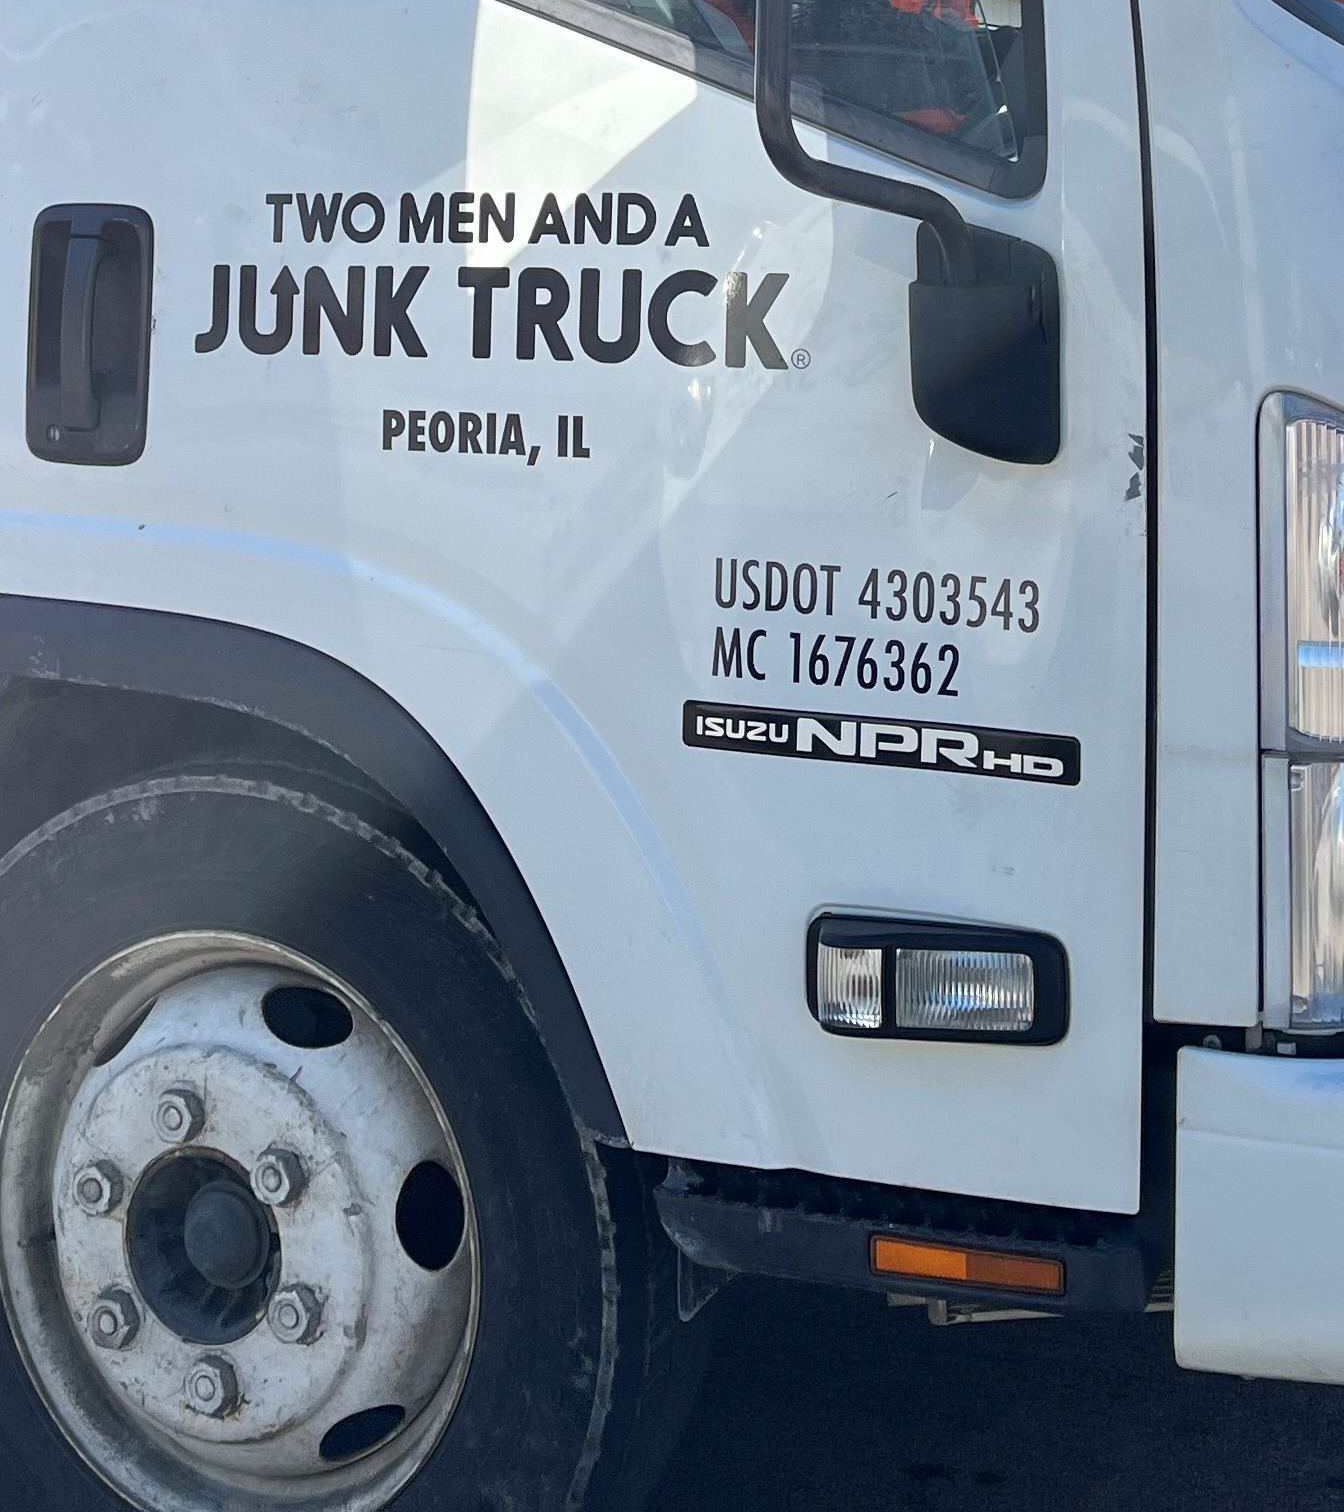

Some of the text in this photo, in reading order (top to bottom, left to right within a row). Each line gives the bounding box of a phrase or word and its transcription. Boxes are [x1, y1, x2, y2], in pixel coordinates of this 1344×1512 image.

[265, 192, 710, 248] TWO MEN AND A
[195, 265, 430, 358] JUNK
[382, 410, 591, 466] PEORIA, IL
[715, 557, 1040, 633] USDOT 4303543
[712, 626, 960, 697] MC 1676362
[696, 716, 789, 743] ISUZU
